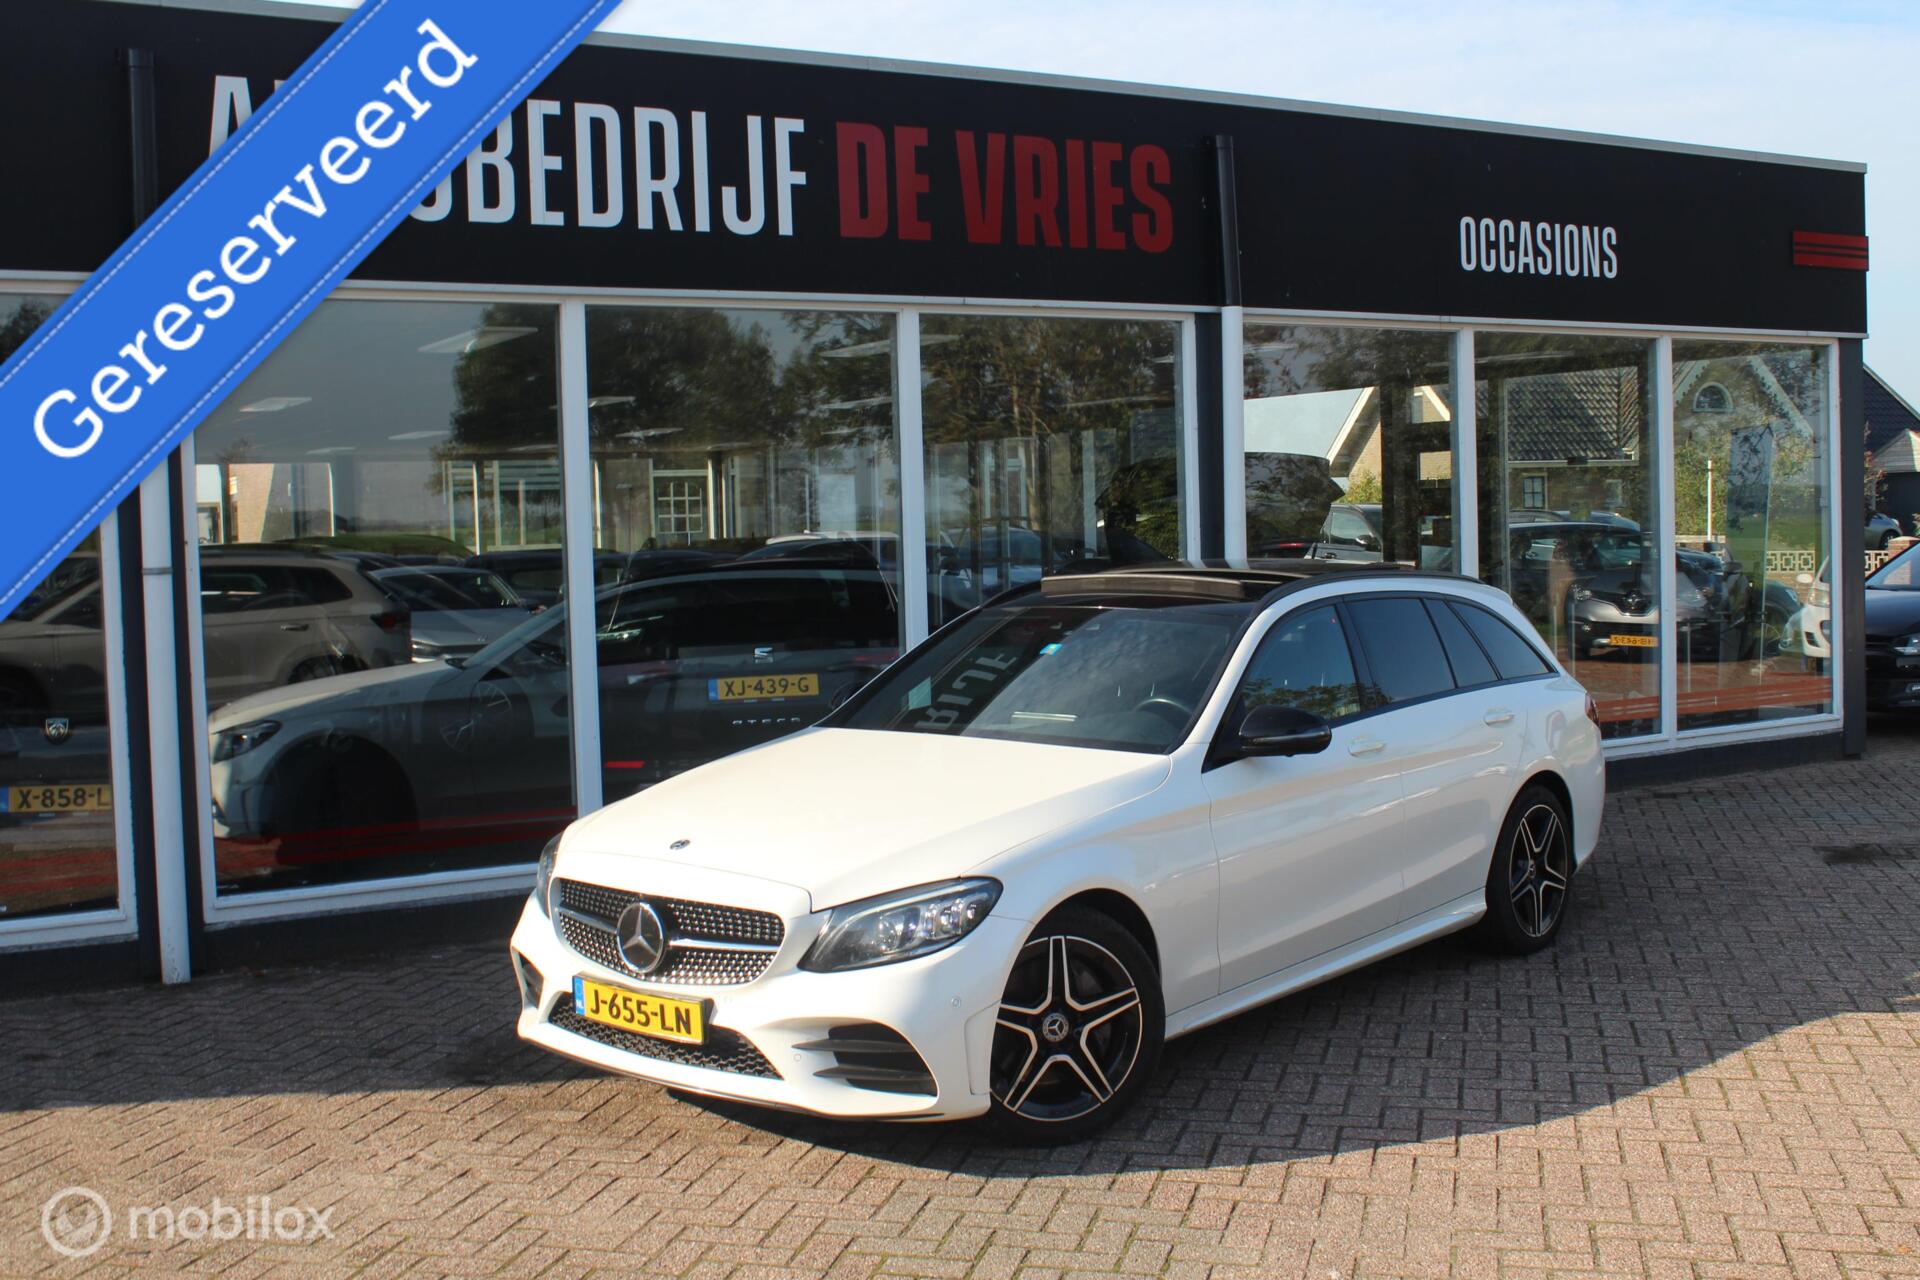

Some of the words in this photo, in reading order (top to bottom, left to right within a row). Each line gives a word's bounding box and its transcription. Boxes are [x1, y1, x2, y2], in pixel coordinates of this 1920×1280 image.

[208, 75, 806, 236] ABEDRIJF
[837, 122, 931, 240] DE
[956, 130, 1173, 253] VRIES
[1459, 216, 1618, 279] OCCASIONS
[724, 677, 809, 697] XJ-439-G
[18, 787, 111, 809] X-858-L
[590, 989, 692, 1034] J-655-LN
